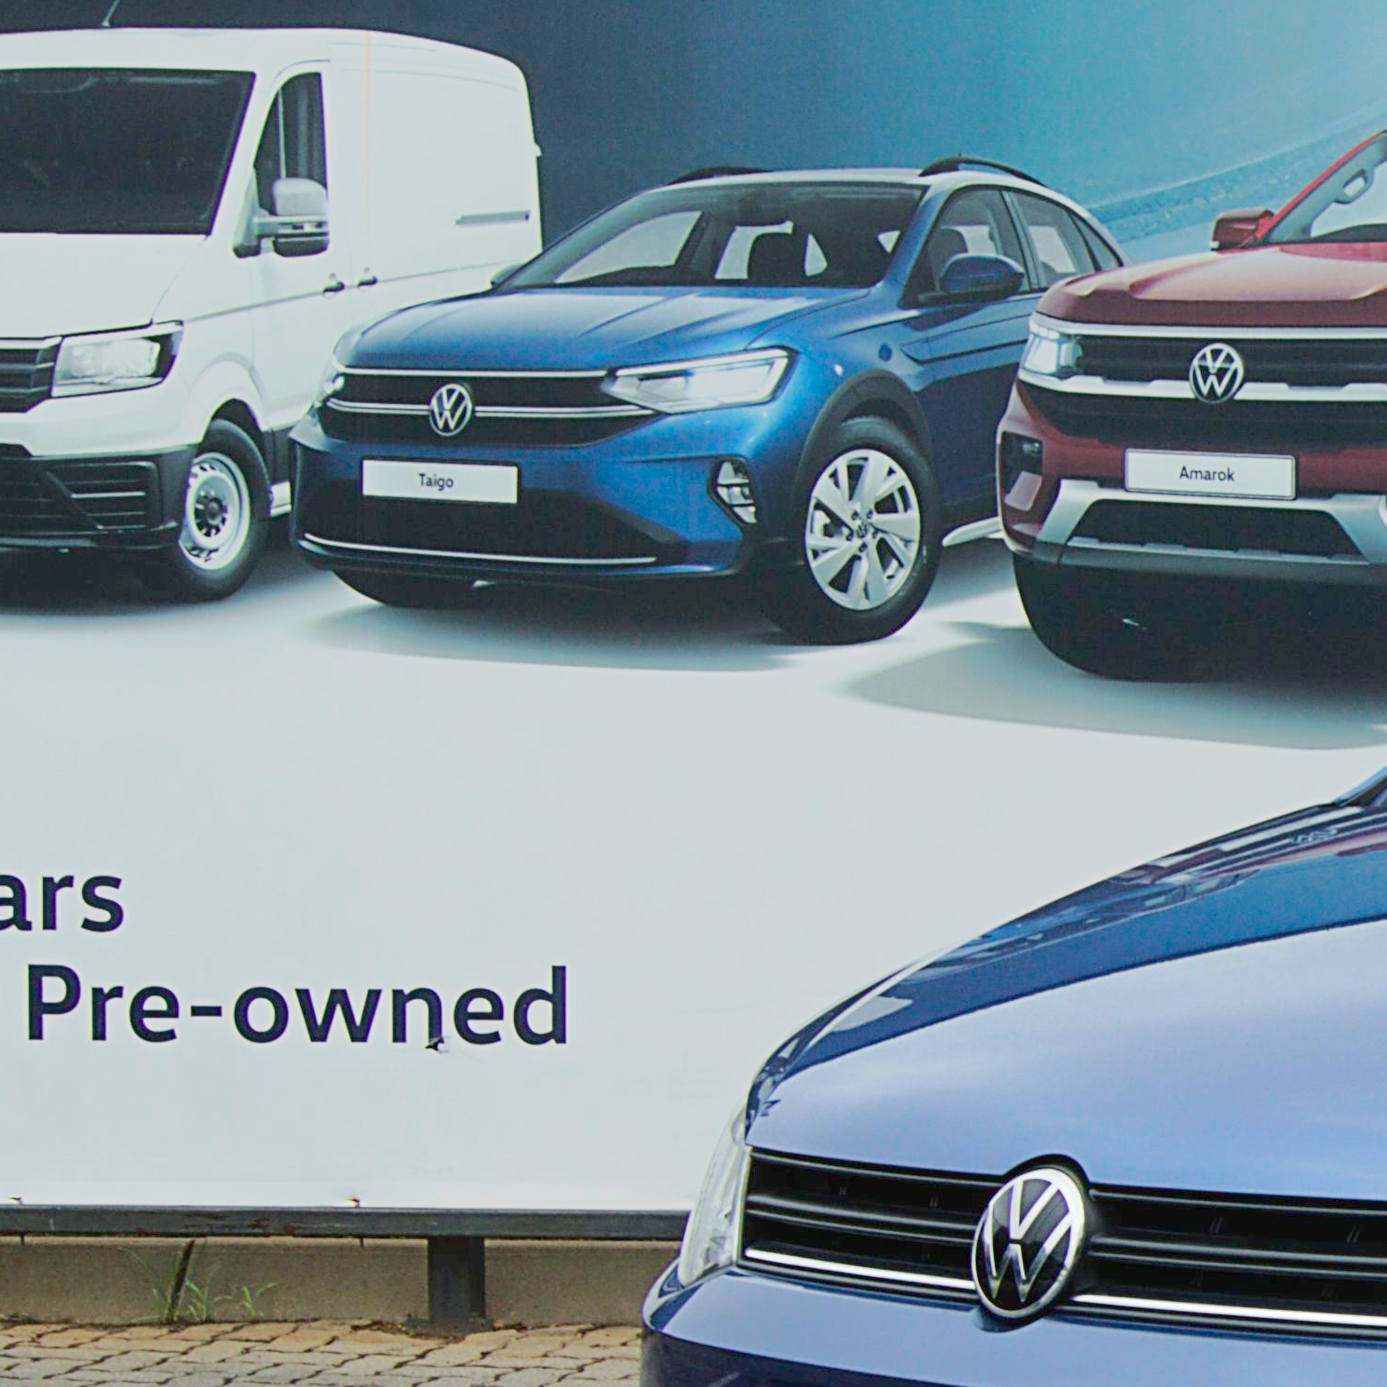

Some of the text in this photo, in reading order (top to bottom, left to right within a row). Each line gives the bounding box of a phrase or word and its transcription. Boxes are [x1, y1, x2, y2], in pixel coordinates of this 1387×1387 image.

[418, 472, 454, 491] Taigo
[1179, 465, 1235, 482] Amarok
[27, 963, 568, 1046] Pre-owned
